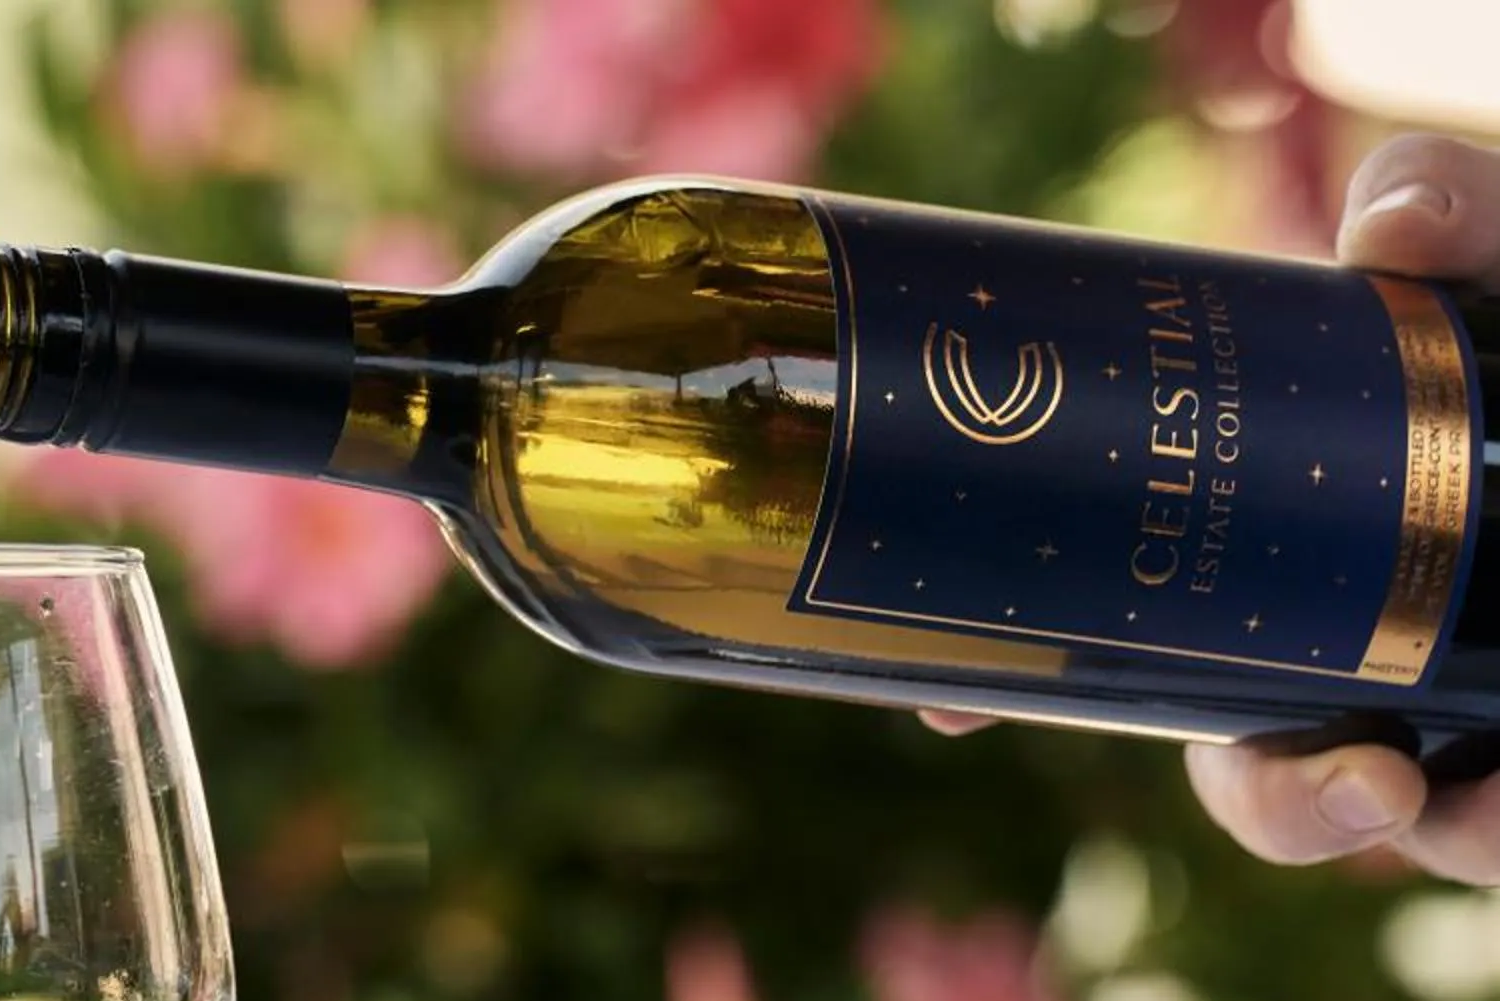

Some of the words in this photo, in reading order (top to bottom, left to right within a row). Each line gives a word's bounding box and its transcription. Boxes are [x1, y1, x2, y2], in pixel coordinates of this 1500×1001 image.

[1131, 274, 1200, 585] CELESTIAL
[1199, 280, 1241, 464] COLLECTION
[1190, 478, 1236, 593] ESTATE
